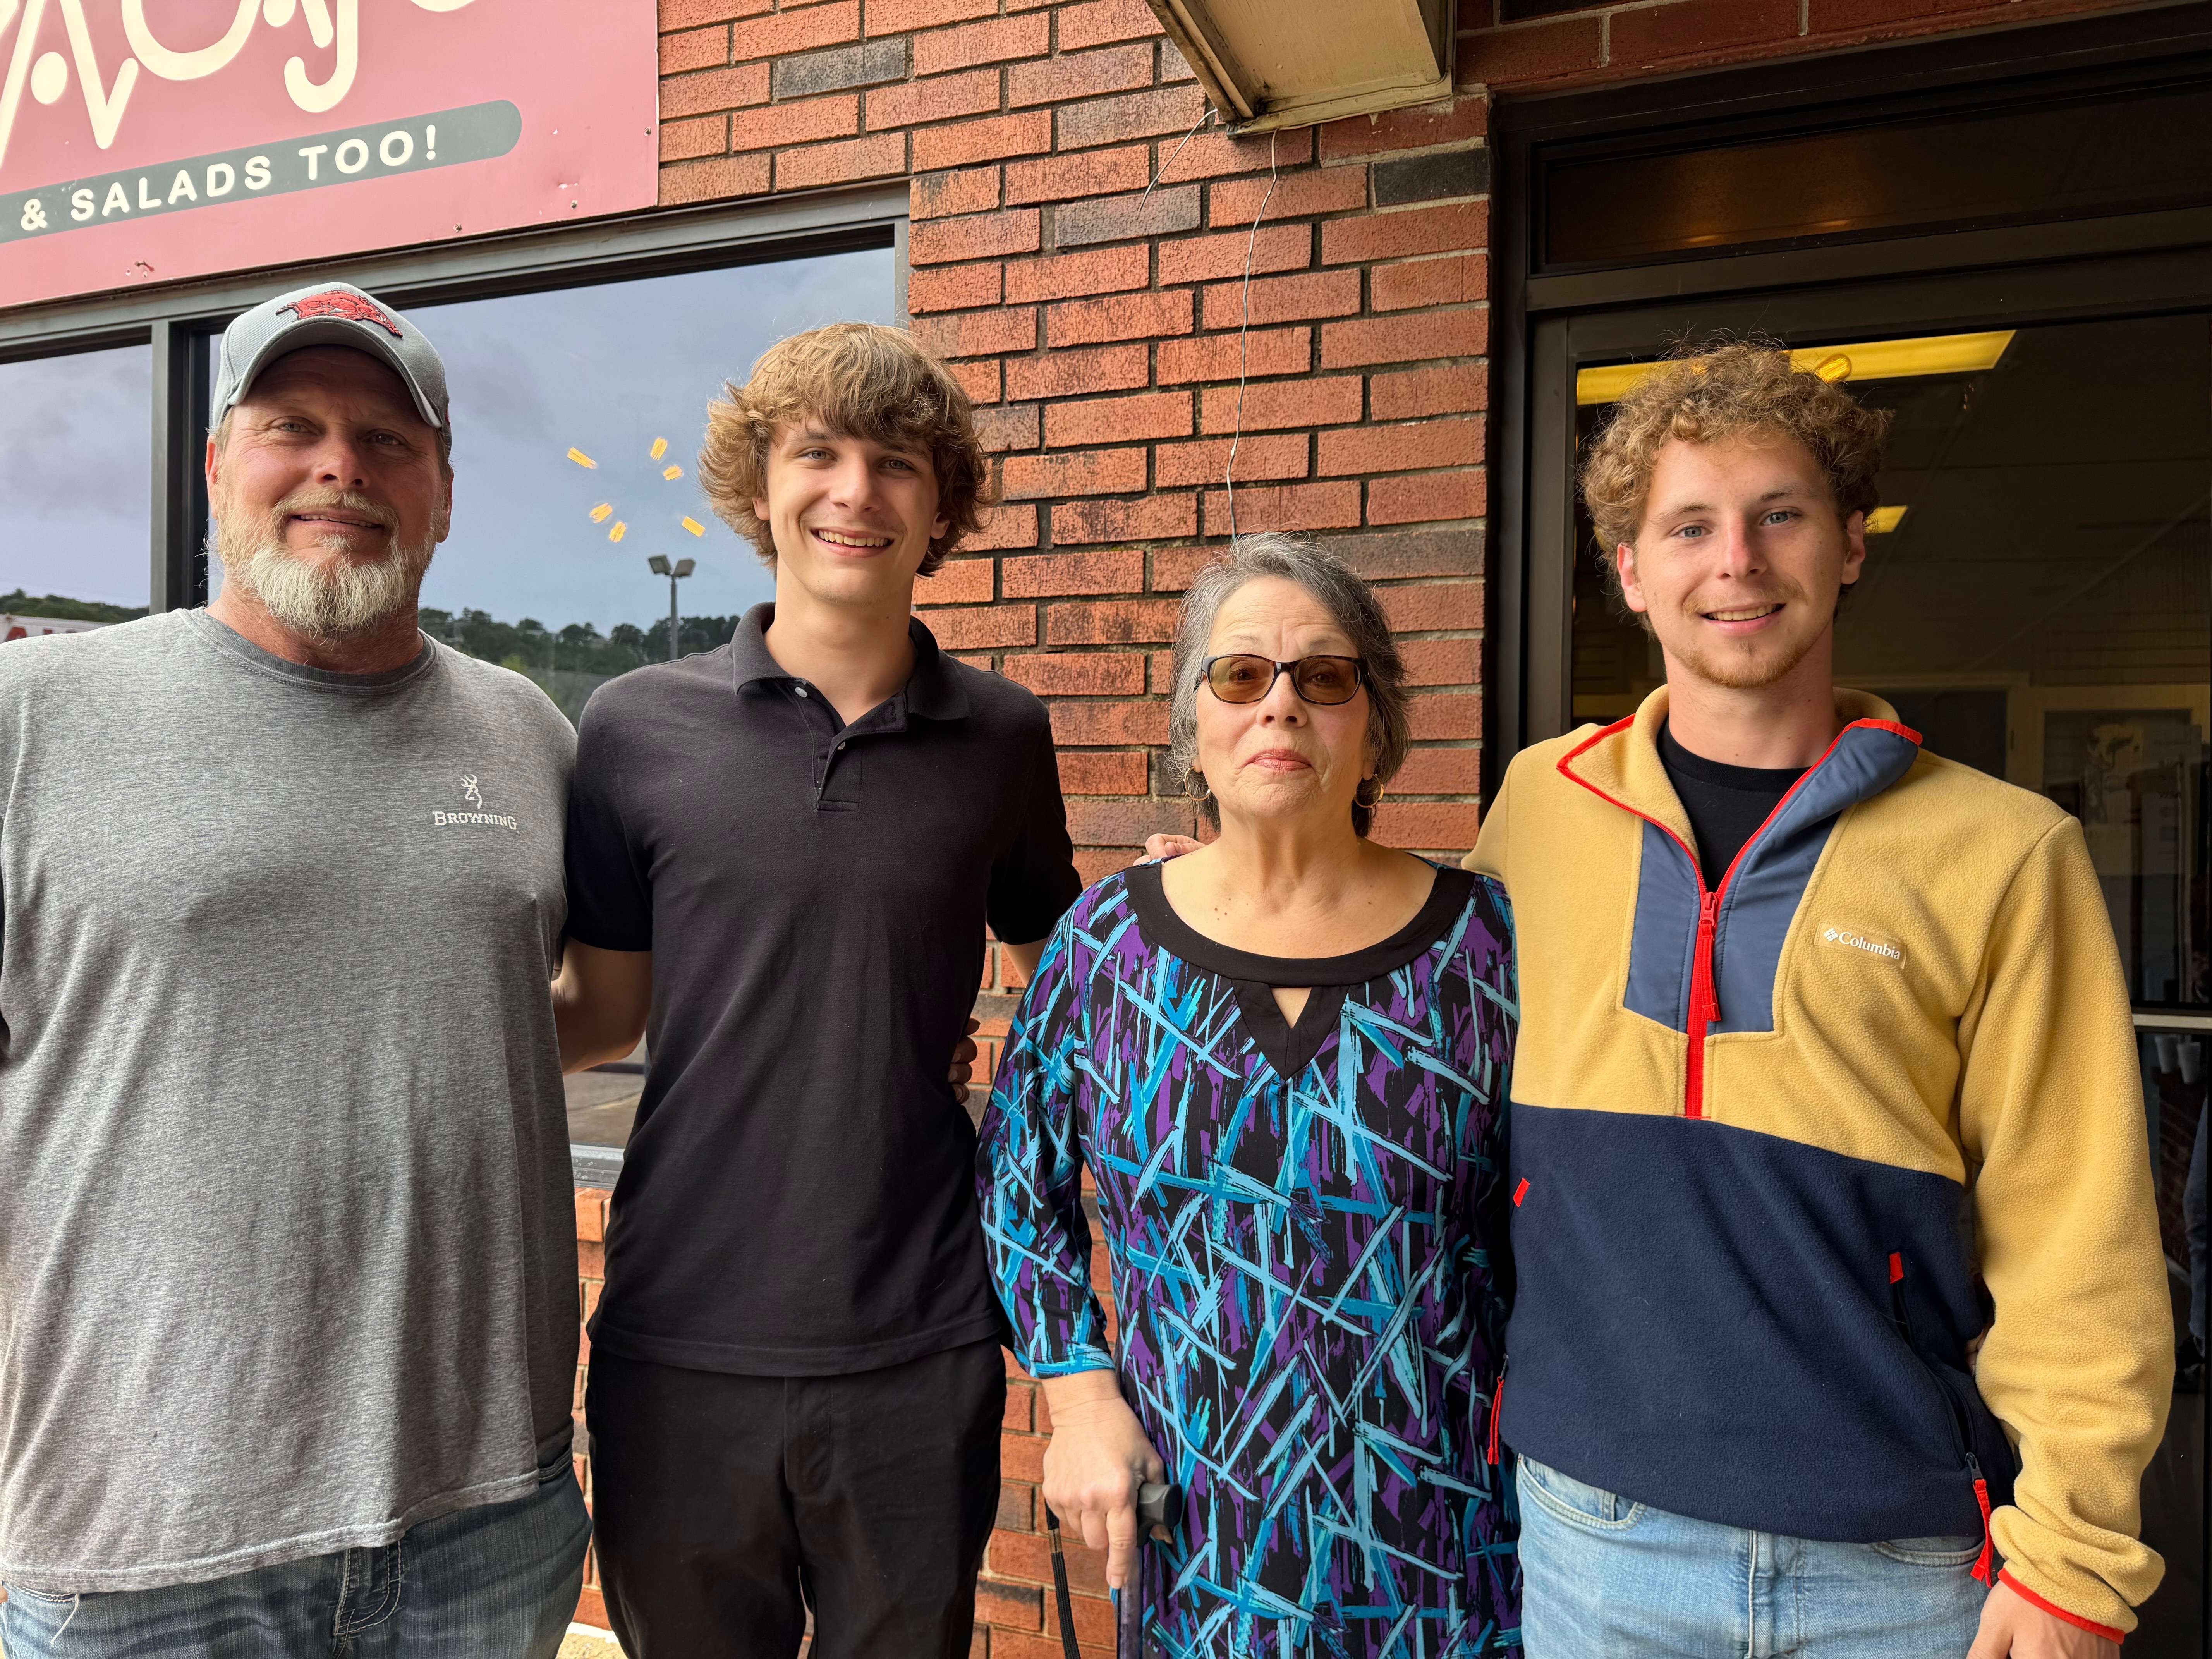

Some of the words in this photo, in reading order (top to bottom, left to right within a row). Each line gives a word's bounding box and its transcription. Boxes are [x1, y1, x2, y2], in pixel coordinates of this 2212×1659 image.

[21, 199, 47, 230] &
[70, 155, 271, 221] SALADS
[298, 124, 436, 180] TOO!
[432, 811, 517, 830] BROWNING
[1839, 931, 1901, 960] Columbia
